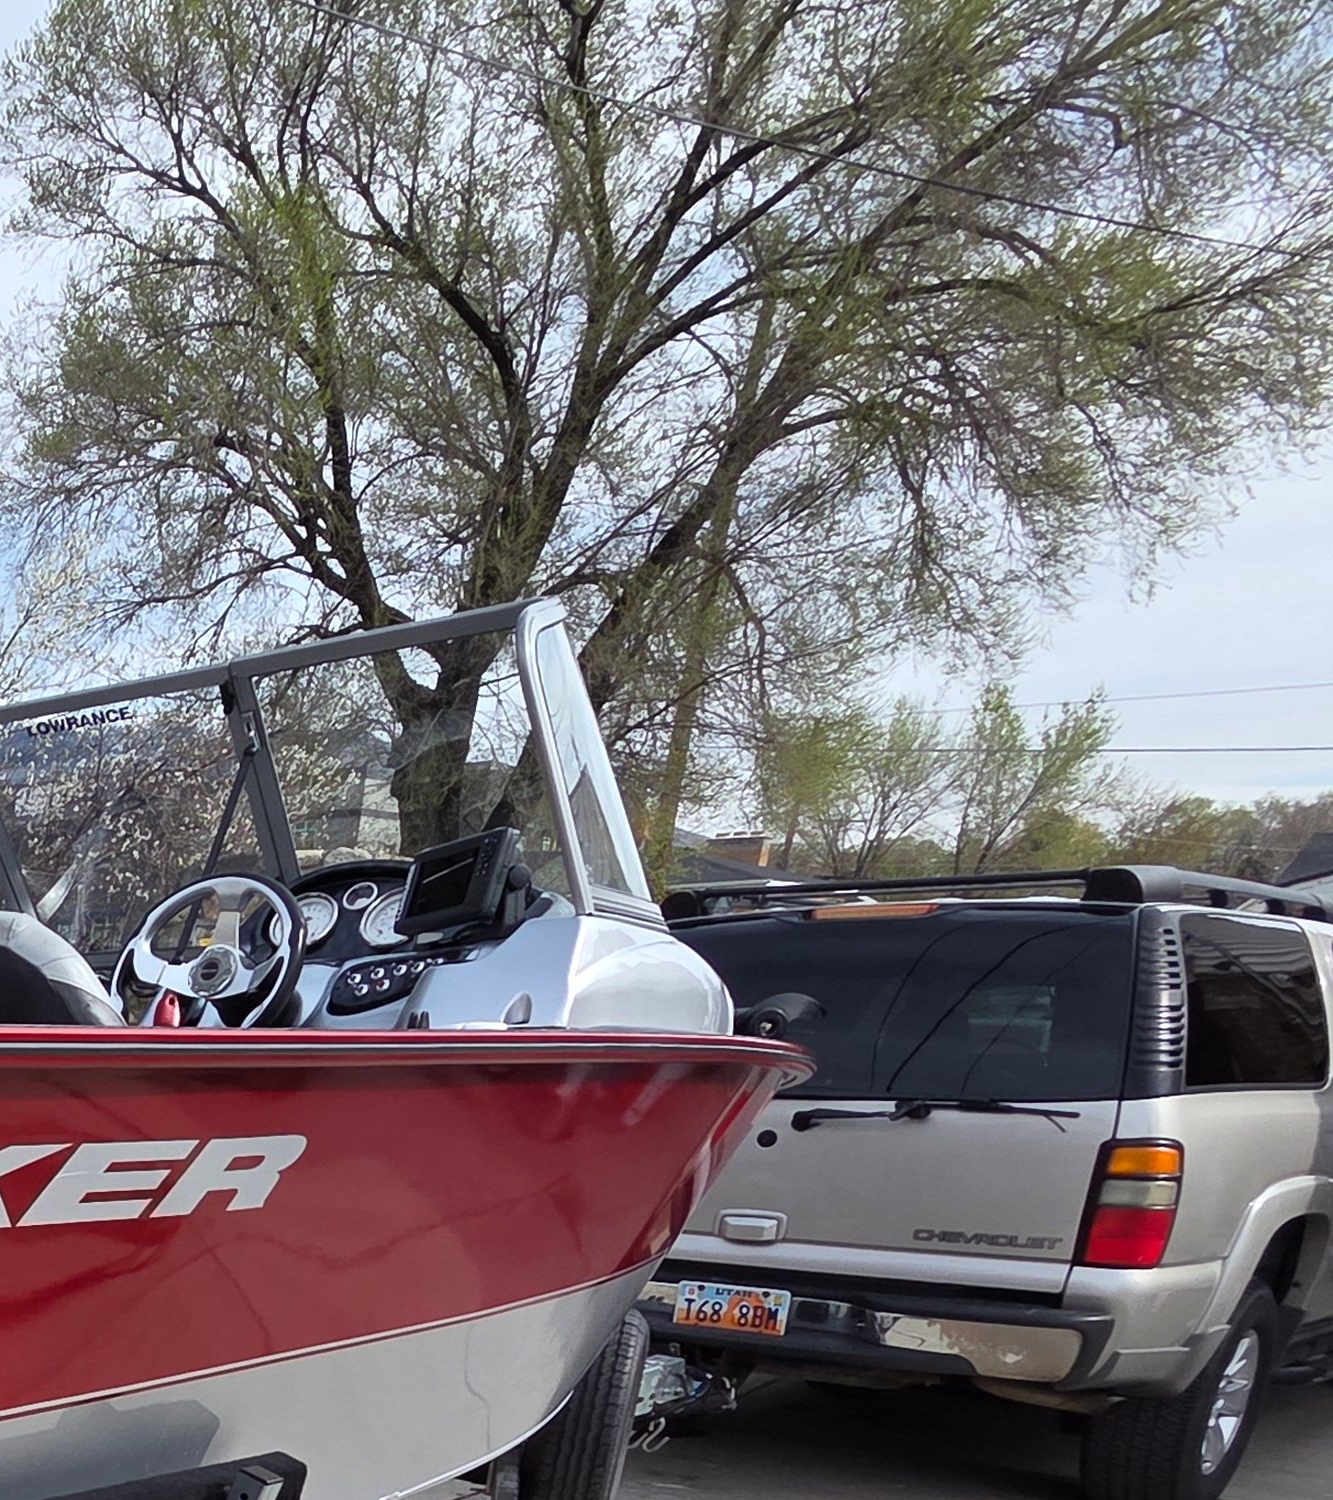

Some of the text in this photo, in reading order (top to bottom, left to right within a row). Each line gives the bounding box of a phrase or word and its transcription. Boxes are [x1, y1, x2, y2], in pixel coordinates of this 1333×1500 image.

[27, 706, 133, 737] LOWRANCE
[913, 1229, 1064, 1250] CHEVROLET
[715, 1287, 752, 1297] UTAH
[684, 1298, 779, 1331] T68 8BM
